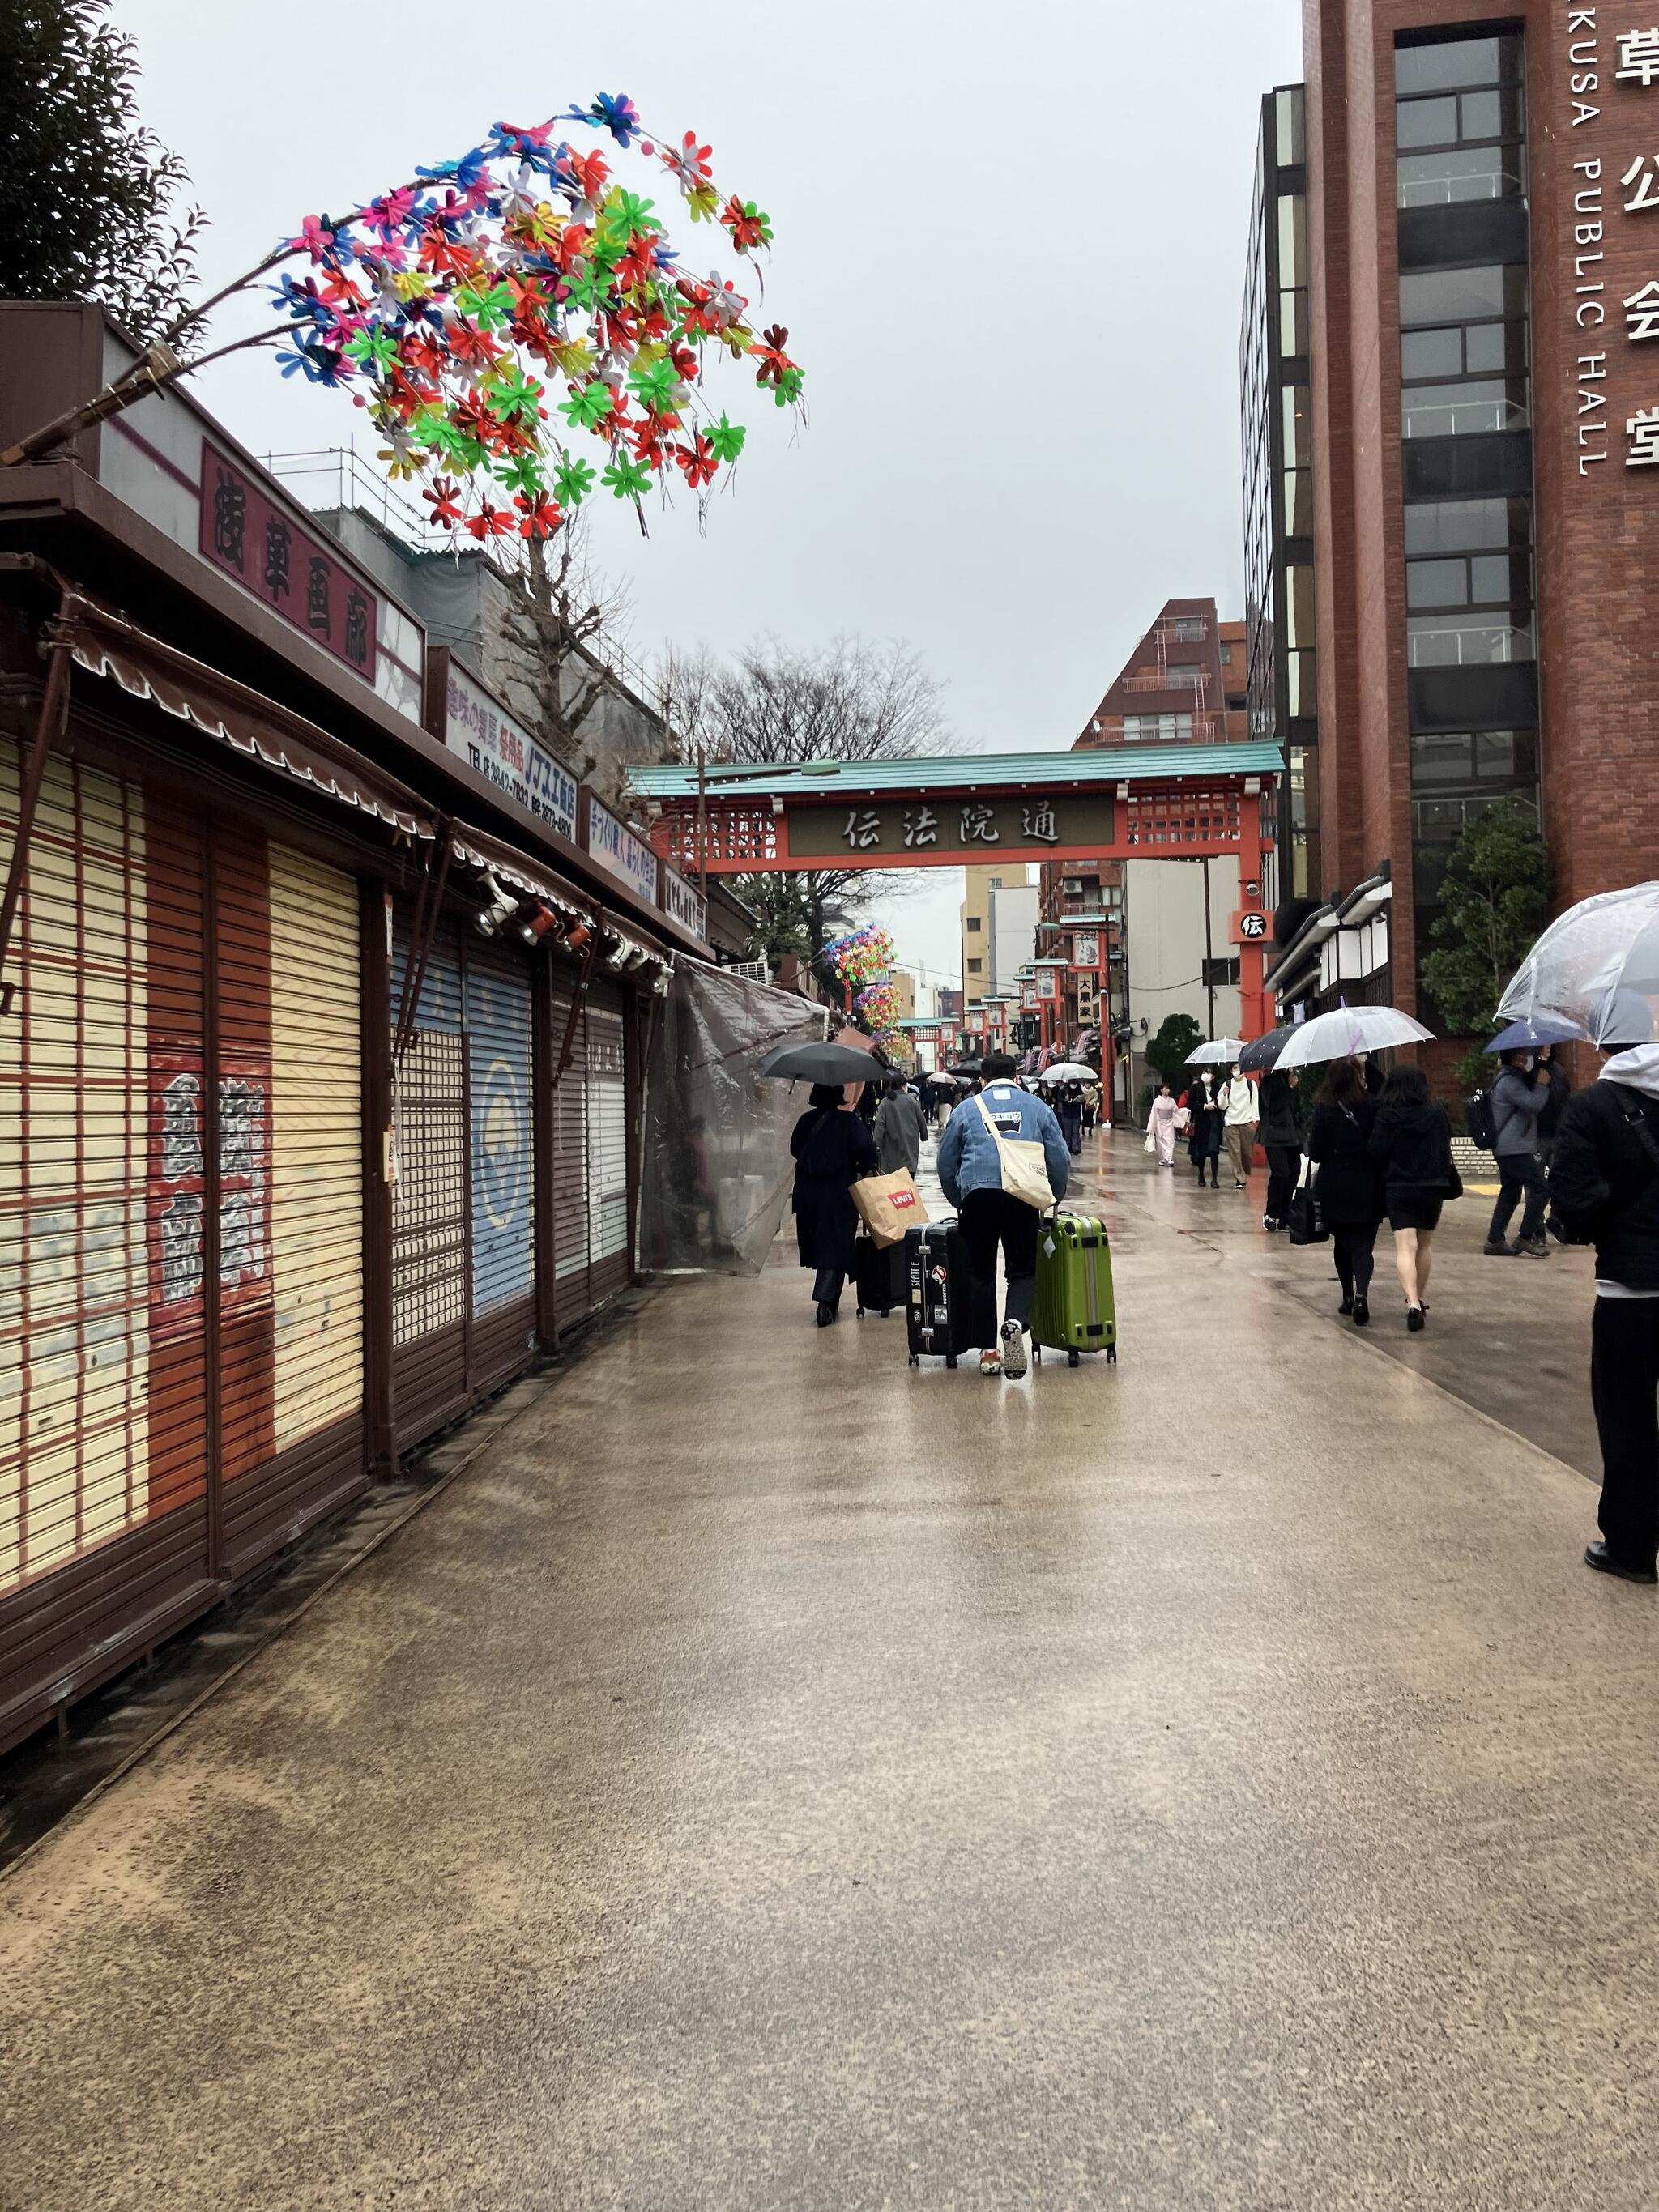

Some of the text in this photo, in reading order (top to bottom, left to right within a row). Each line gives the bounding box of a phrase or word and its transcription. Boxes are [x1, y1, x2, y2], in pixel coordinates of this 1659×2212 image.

[1568, 0, 1607, 475] KUSA PUBLIC HALL
[467, 741, 482, 773] TEL
[843, 800, 1060, 847] 伝法院通
[1242, 915, 1264, 936] 伝
[1079, 978, 1092, 1017] 大黒家
[911, 1261, 921, 1287] SEATTE
